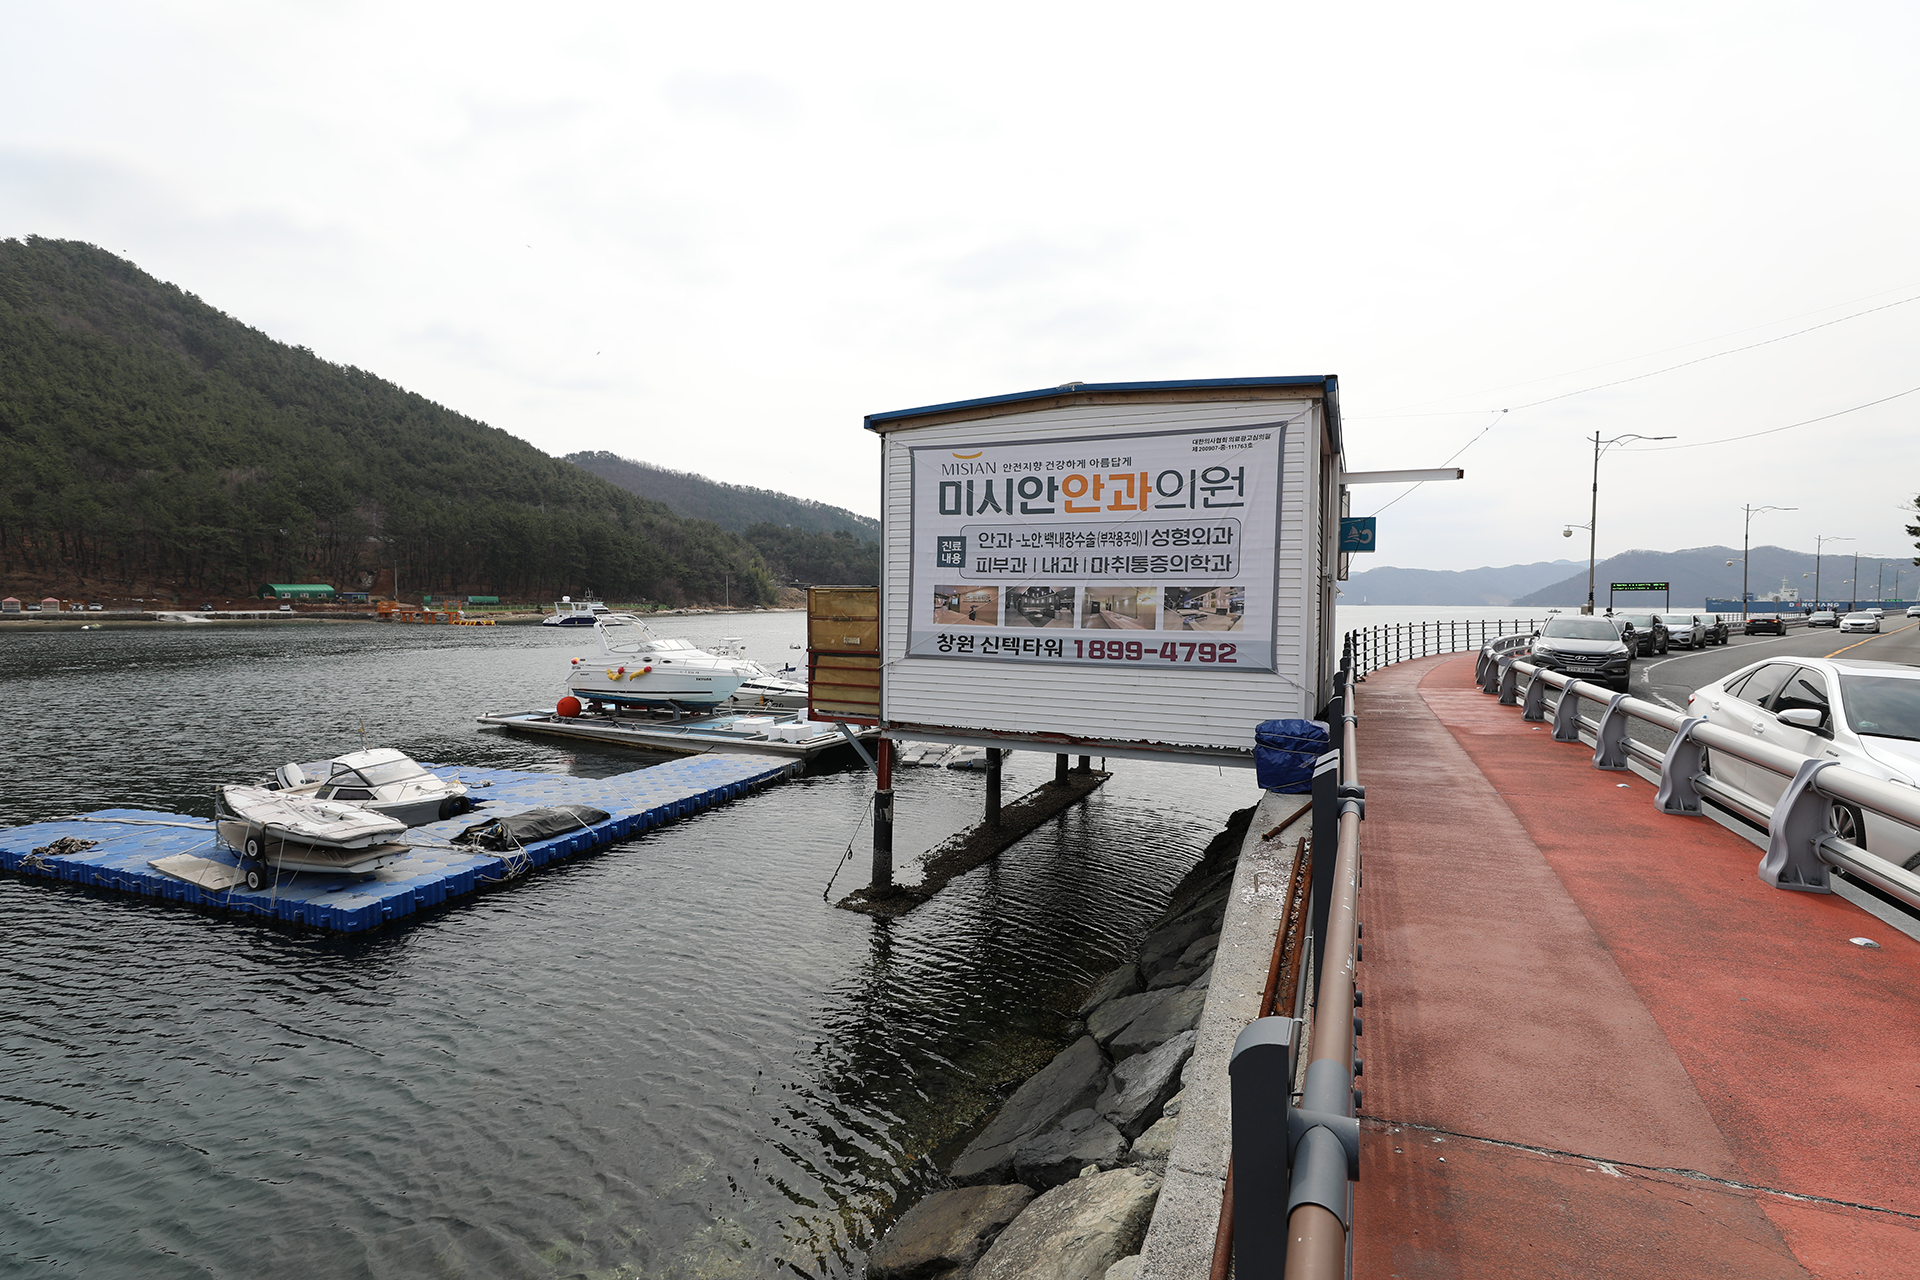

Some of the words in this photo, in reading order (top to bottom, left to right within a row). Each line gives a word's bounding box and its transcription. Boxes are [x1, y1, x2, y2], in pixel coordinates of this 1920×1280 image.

[941, 461, 996, 476] MISIAN
[1002, 460, 1042, 473] 안전지향
[1045, 458, 1086, 471] 건강하게
[1089, 456, 1132, 469] 아름답게
[939, 466, 1244, 516] 미시안안과의원
[942, 540, 962, 552] 진료
[1151, 527, 1233, 547] 성형외과
[942, 552, 962, 564] 내용
[976, 557, 1027, 573] 피부과
[1042, 556, 1079, 573] 내과
[1091, 554, 1232, 574] 마취통증의학과
[936, 633, 974, 653] 창원
[980, 635, 1063, 658] 신텍타워
[1074, 639, 1237, 663] 1899-4792
